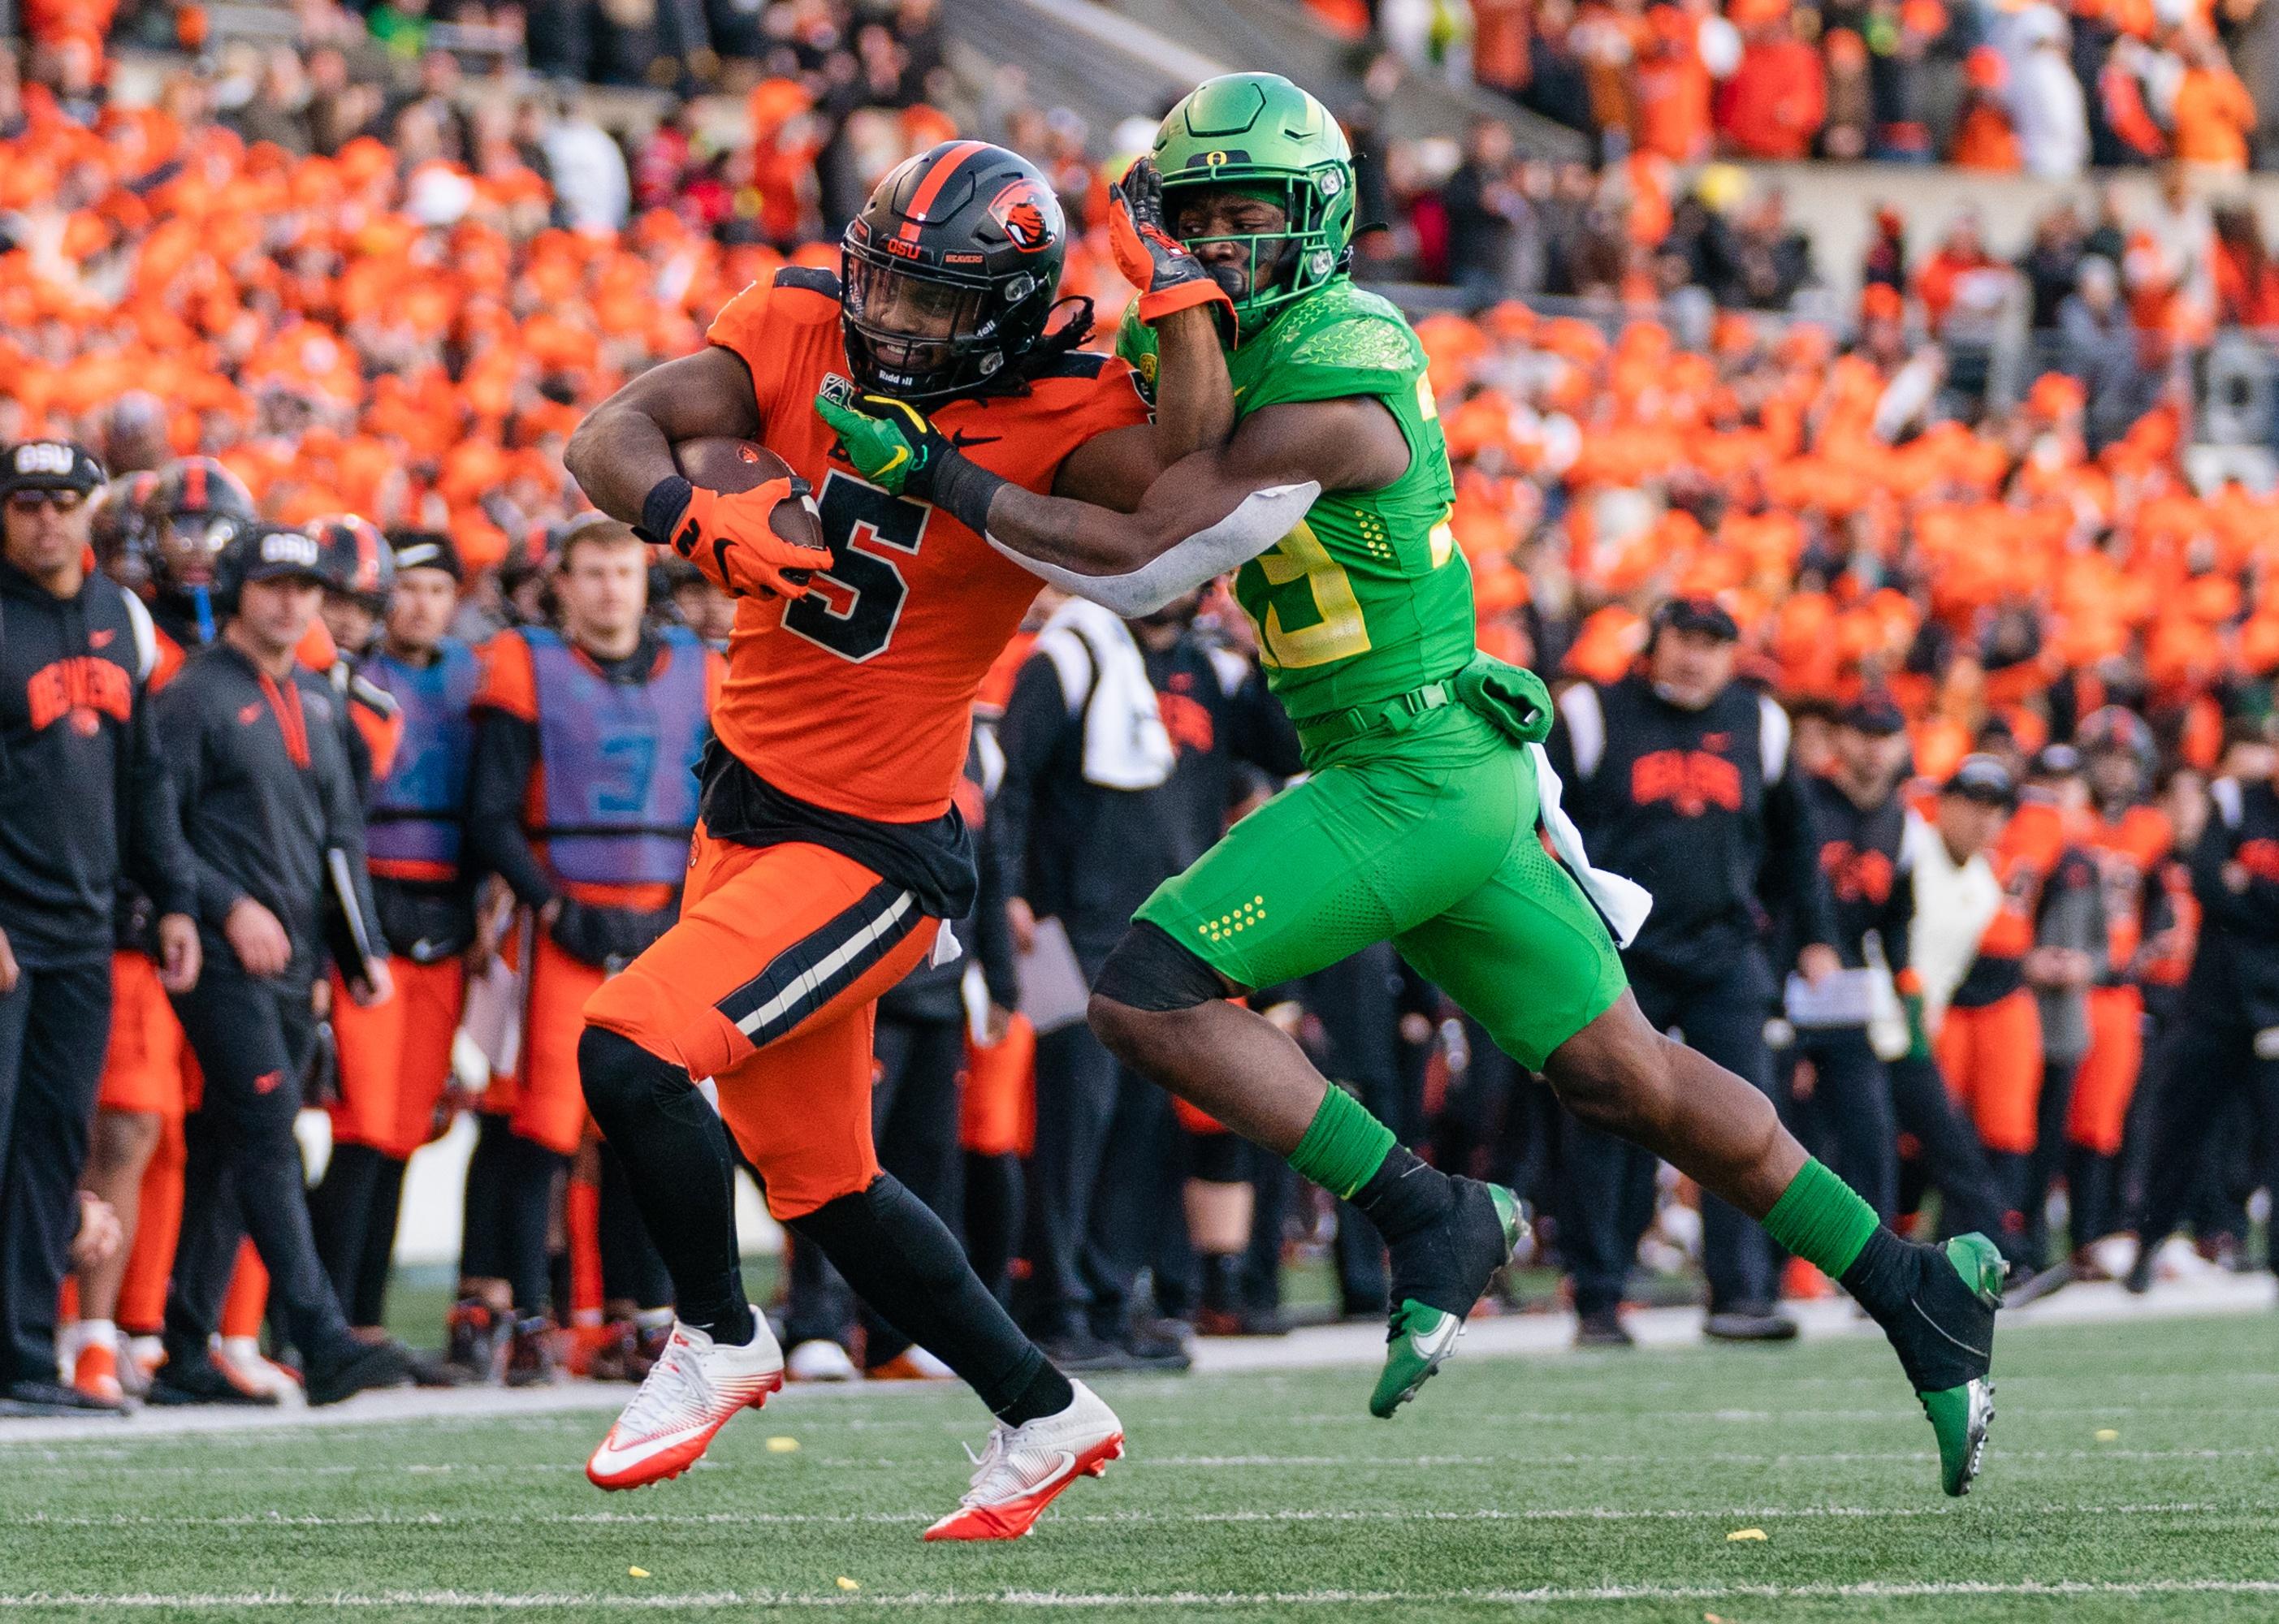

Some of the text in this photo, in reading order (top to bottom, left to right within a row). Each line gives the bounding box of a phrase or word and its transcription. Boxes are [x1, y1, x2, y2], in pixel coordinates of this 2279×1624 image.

[1206, 151, 1227, 167] O
[888, 238, 922, 260] OSU
[879, 369, 913, 387] Riddll
[15, 443, 75, 474] OSU
[781, 468, 932, 664] 5
